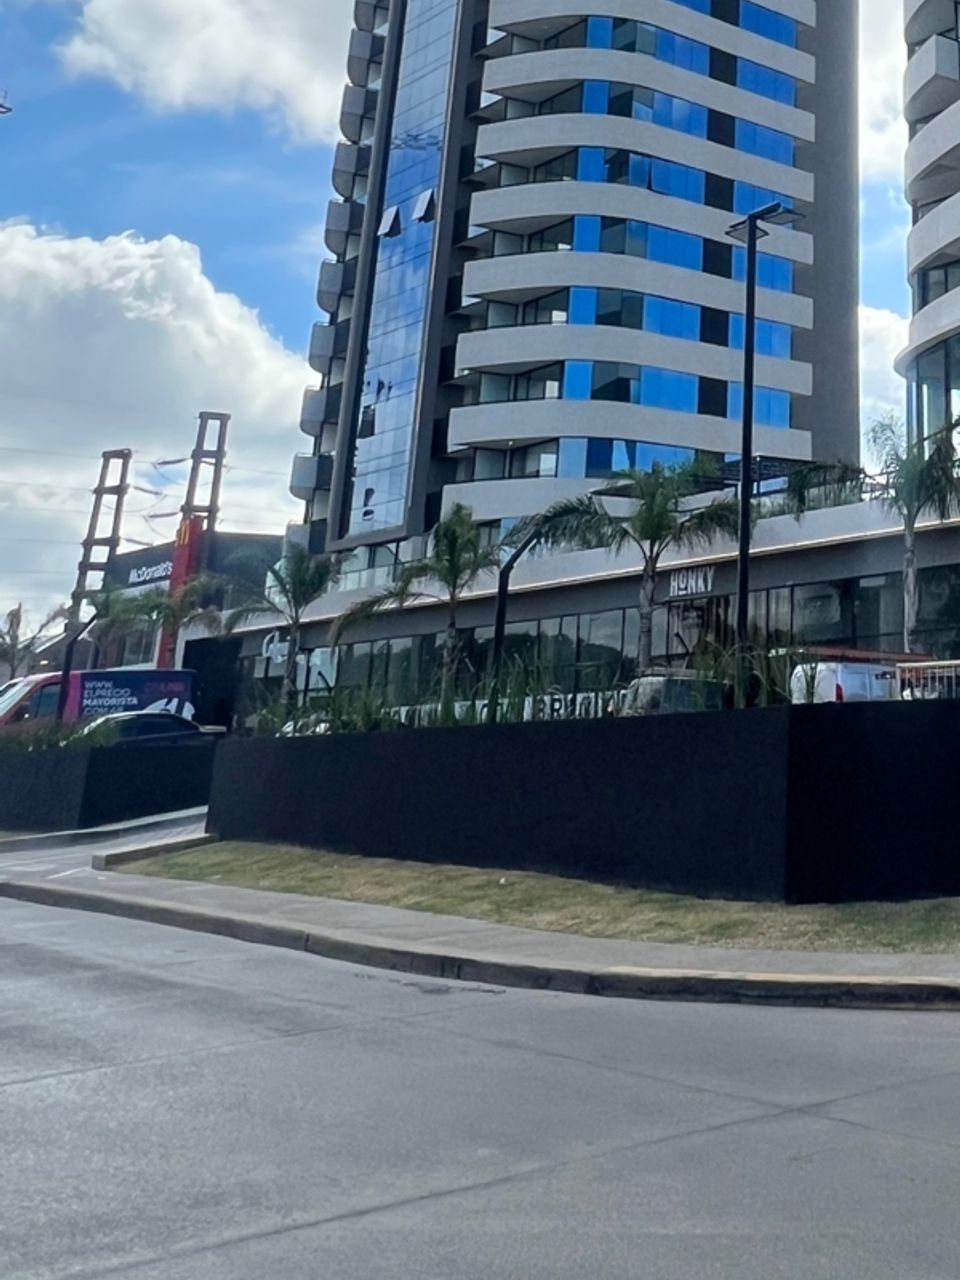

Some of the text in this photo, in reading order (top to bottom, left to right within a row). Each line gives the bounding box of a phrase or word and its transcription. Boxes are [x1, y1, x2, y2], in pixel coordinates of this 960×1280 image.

[129, 561, 173, 583] McDonald's
[670, 566, 715, 596] HONKY
[82, 697, 138, 706] MAYORISTA
